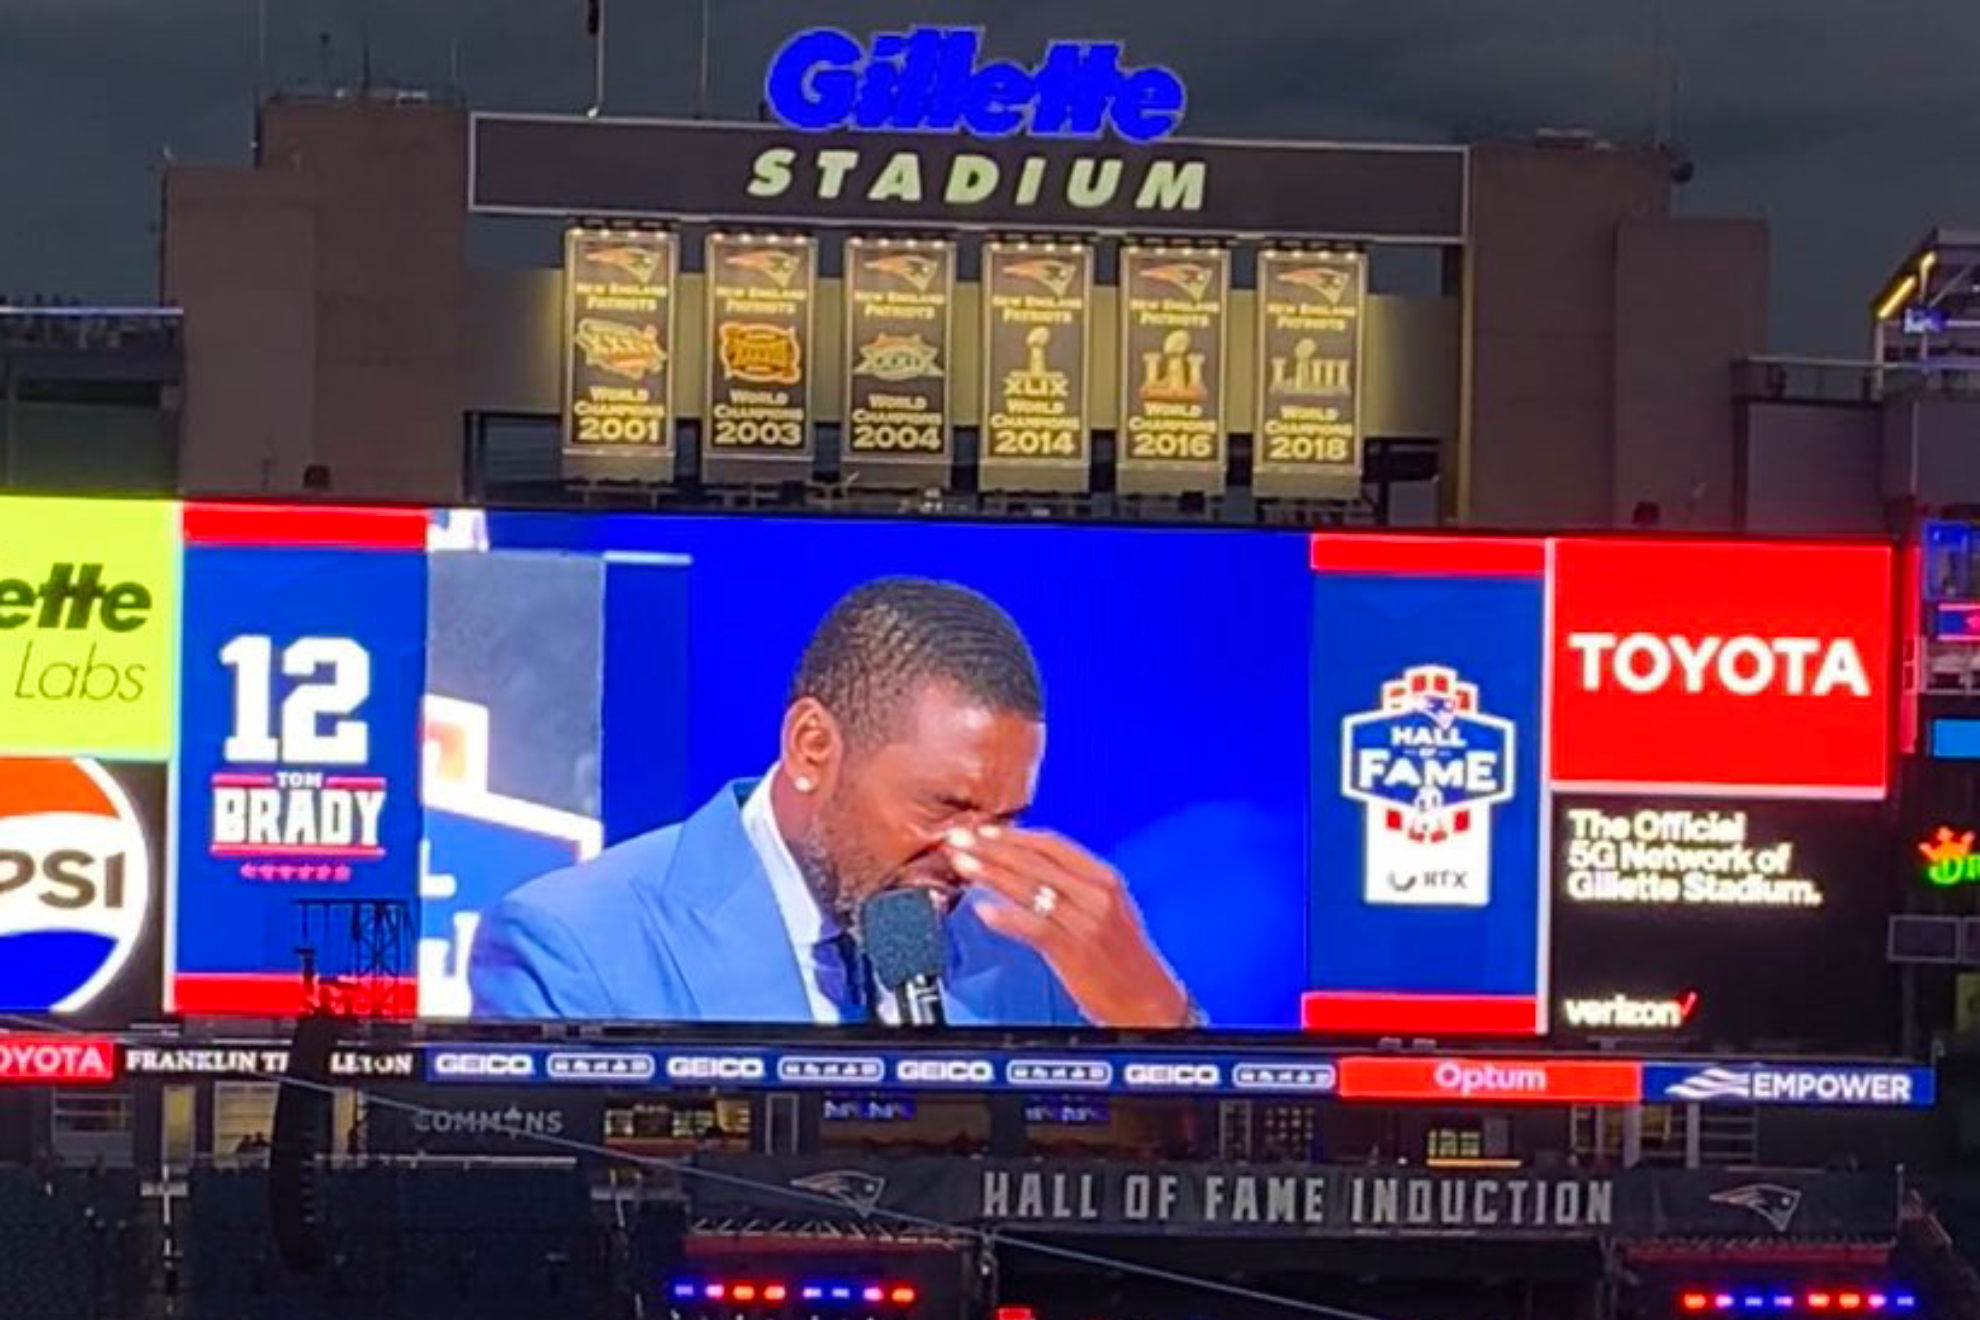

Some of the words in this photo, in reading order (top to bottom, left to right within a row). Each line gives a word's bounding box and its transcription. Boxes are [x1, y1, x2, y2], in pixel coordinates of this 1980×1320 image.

[767, 25, 1186, 143] Gillette
[747, 149, 1206, 210] STADIUM
[1004, 377, 1069, 397] XLIX
[578, 417, 660, 442] 2001
[715, 421, 802, 445] 2003
[853, 425, 940, 450] 2004
[994, 429, 1075, 455] 2014
[1133, 432, 1212, 457] 2016
[1269, 436, 1348, 460] 2018
[0, 562, 152, 632] ette
[15, 640, 146, 702] Labs
[1568, 631, 1871, 697] TOYOTA
[220, 634, 371, 765] 12
[1391, 725, 1468, 747] HALL
[276, 772, 323, 788] TOM
[1358, 748, 1498, 792] FAME
[214, 787, 386, 846] BRADY
[1568, 808, 1630, 839] The
[1634, 810, 1746, 843] Official
[1567, 839, 1616, 869] 5G
[1620, 841, 1752, 872] Network
[1756, 842, 1792, 874] of
[1567, 870, 1680, 901] Gillette
[1682, 872, 1823, 905] Stadium.
[1565, 994, 1682, 1027] verizon
[126, 1050, 256, 1073] FRANKLIN
[435, 1054, 532, 1075] GEICO
[667, 1057, 764, 1078] GEICO
[897, 1060, 994, 1081] GEICO
[1125, 1064, 1220, 1085] GEICO
[1434, 1063, 1547, 1095] Optum
[1753, 1073, 1912, 1100] EMPOWER
[414, 1109, 564, 1133] COMMNS
[983, 1171, 1098, 1219] HALL
[1124, 1175, 1178, 1221] OF
[1205, 1176, 1325, 1223] FAME
[1351, 1178, 1614, 1225] INDUCTION
